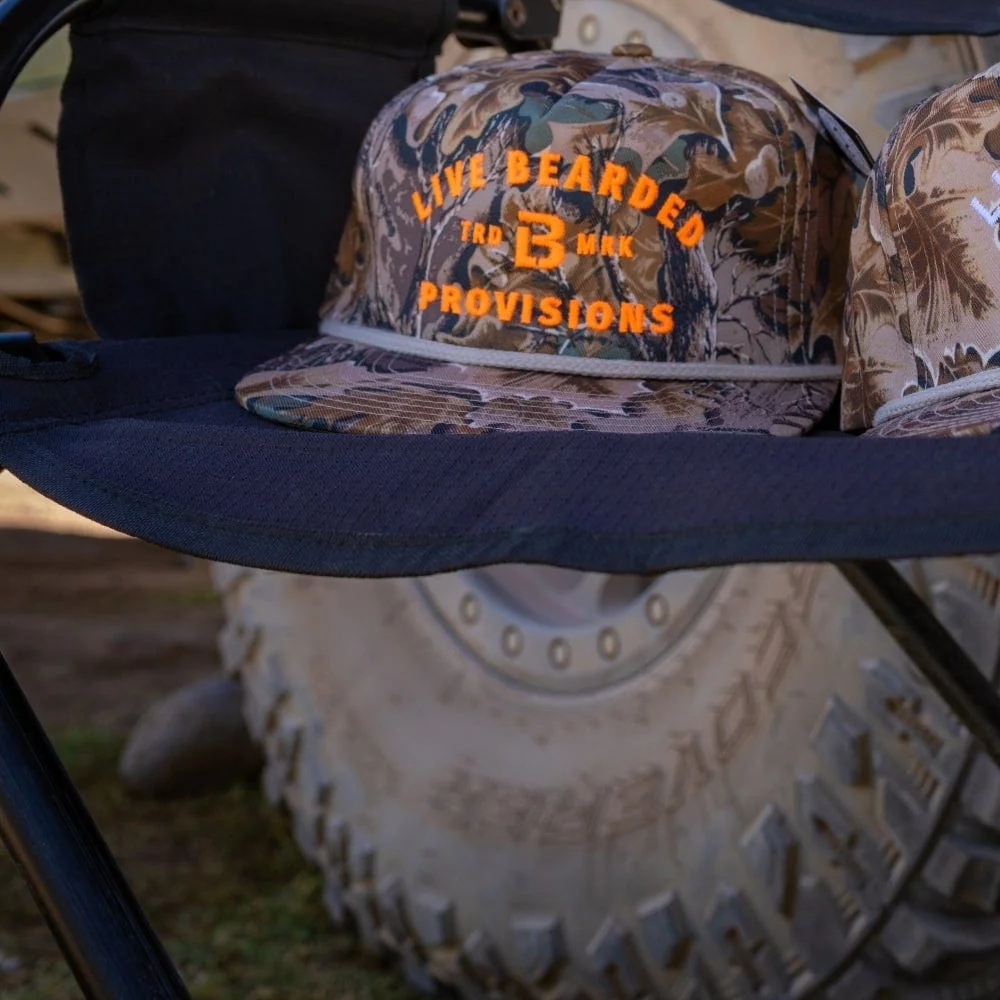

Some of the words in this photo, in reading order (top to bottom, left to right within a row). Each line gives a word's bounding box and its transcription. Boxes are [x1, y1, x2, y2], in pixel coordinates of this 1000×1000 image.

[411, 152, 486, 222] LIVE
[507, 149, 705, 248] BEARDED
[460, 220, 503, 246] TRD
[514, 209, 567, 270] B
[576, 233, 634, 258] MRK
[418, 280, 675, 334] PROVISIONS
